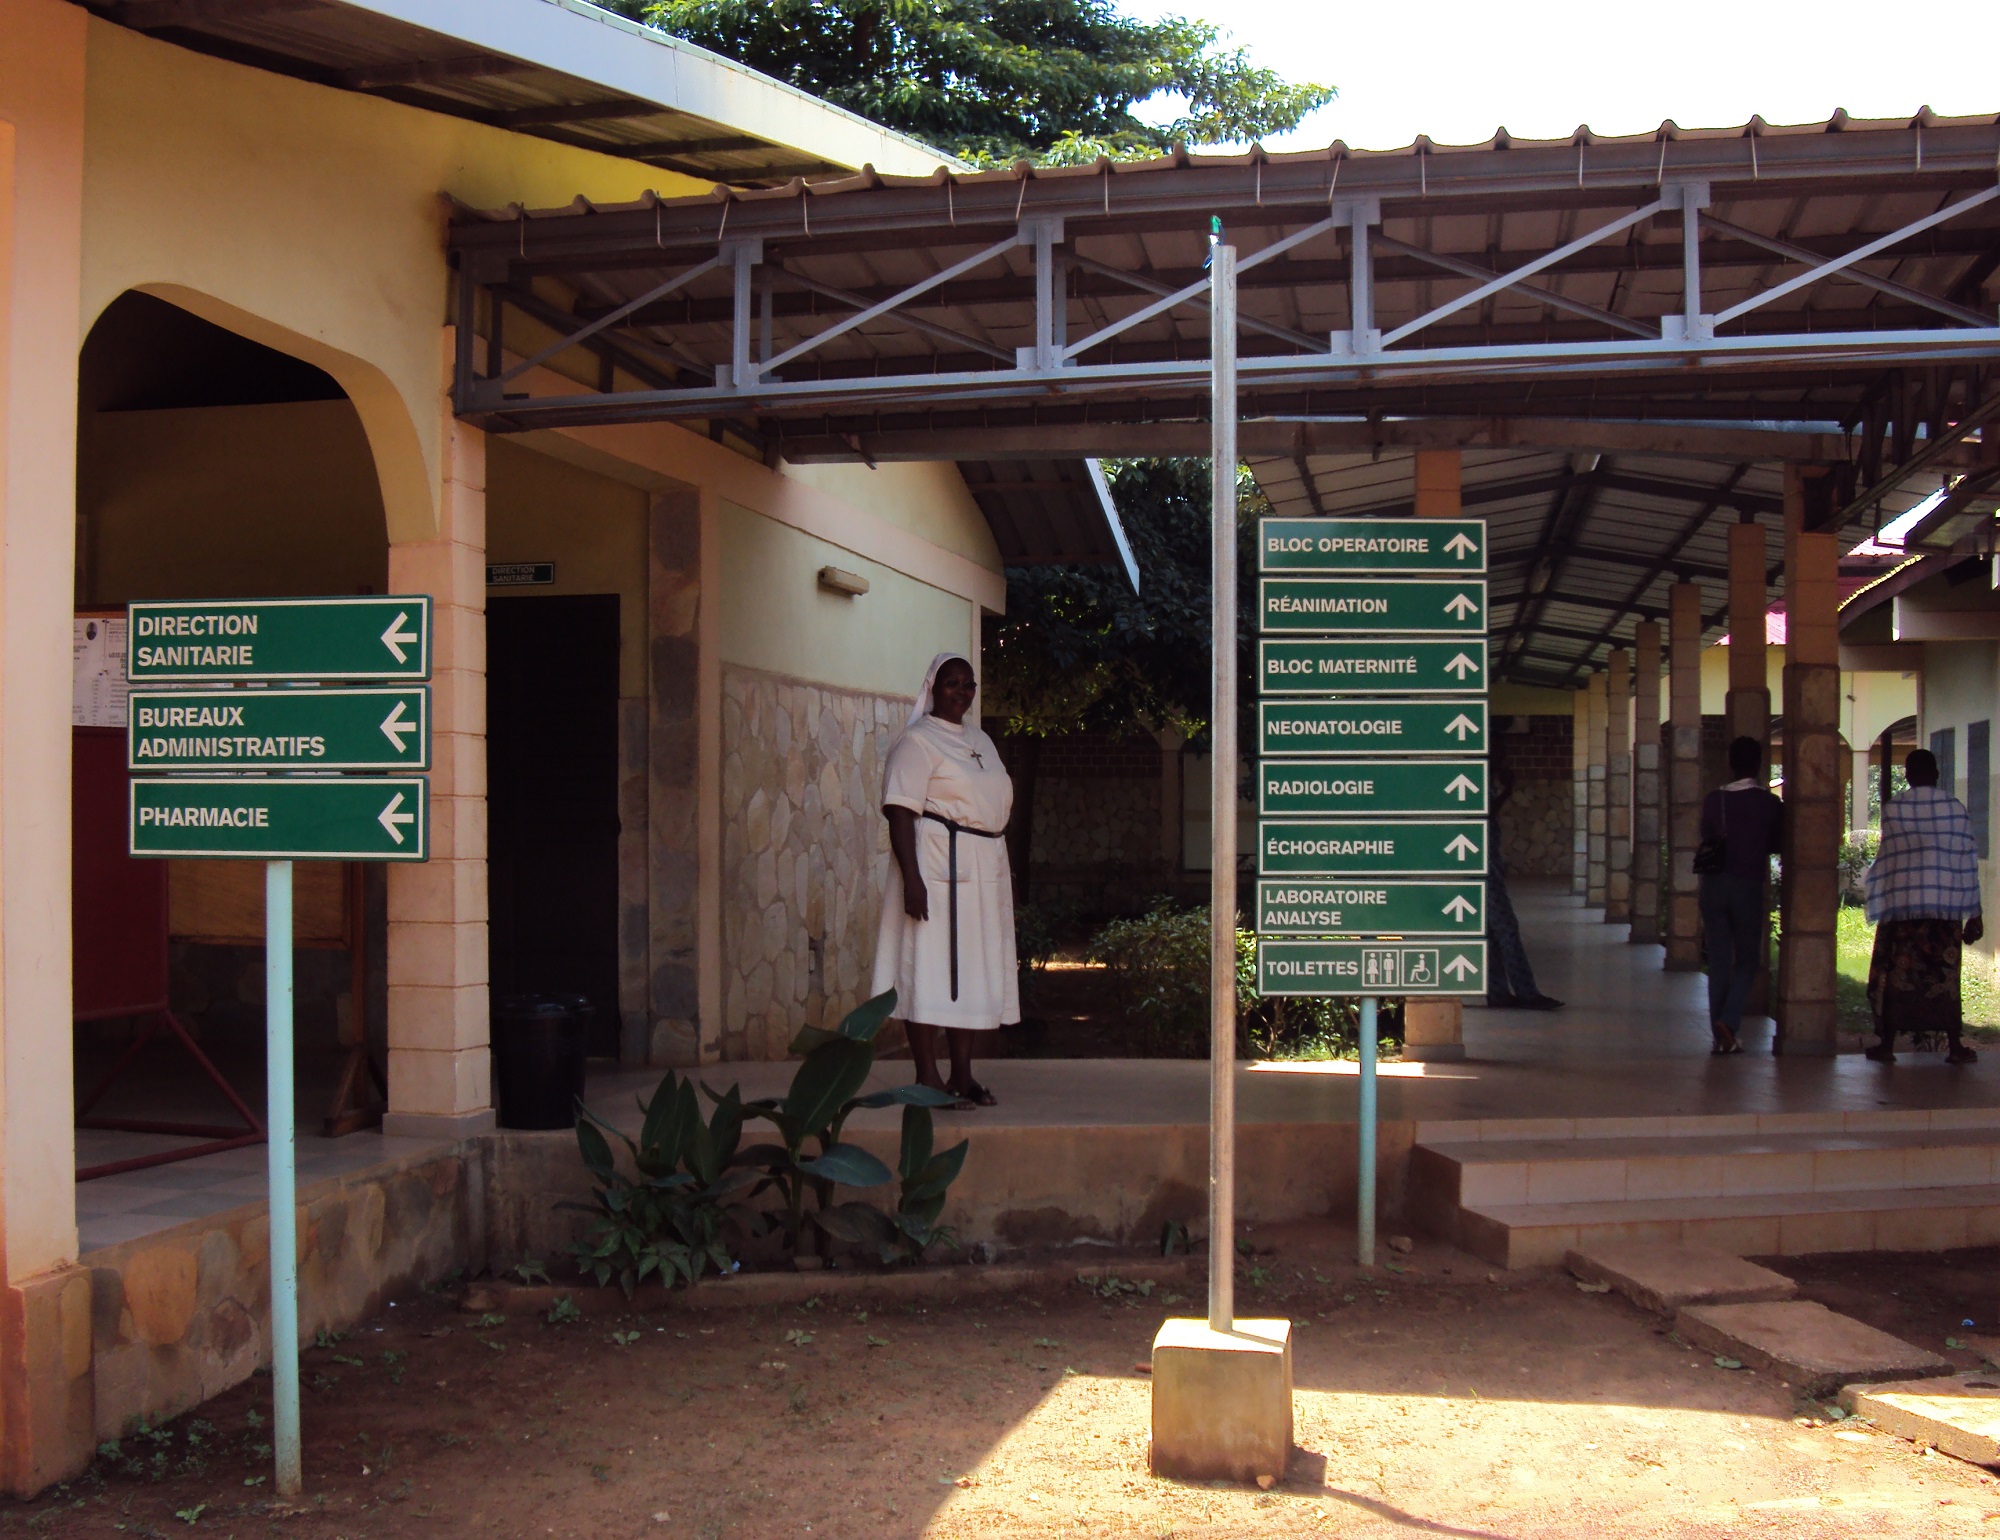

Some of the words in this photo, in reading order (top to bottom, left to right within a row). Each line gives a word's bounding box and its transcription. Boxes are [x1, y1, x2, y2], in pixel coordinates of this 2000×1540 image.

[1267, 537, 1313, 553] BLOC
[1317, 537, 1430, 553] OPERATOIRE
[492, 566, 535, 575] DIRECTION
[1267, 595, 1388, 614] RÉANIMATION
[138, 614, 258, 637] DIRECTION
[137, 645, 253, 667] SANITARIE
[1267, 659, 1314, 674] BLOC
[1318, 655, 1418, 674] MATERNITÉ
[139, 706, 245, 728] BUREAUX
[1267, 719, 1403, 736] NEONATOLOGIE
[137, 736, 326, 758] ADMINISTRATIFS
[1267, 779, 1375, 796] RADIOLOGIE
[139, 807, 269, 828] PHARMACIE
[1267, 837, 1395, 856] ÉCHOGRAPHIE
[1265, 889, 1387, 905] LABORATOIRE
[1264, 910, 1342, 926] ANALYSE
[1266, 960, 1359, 976] TOILETTES
